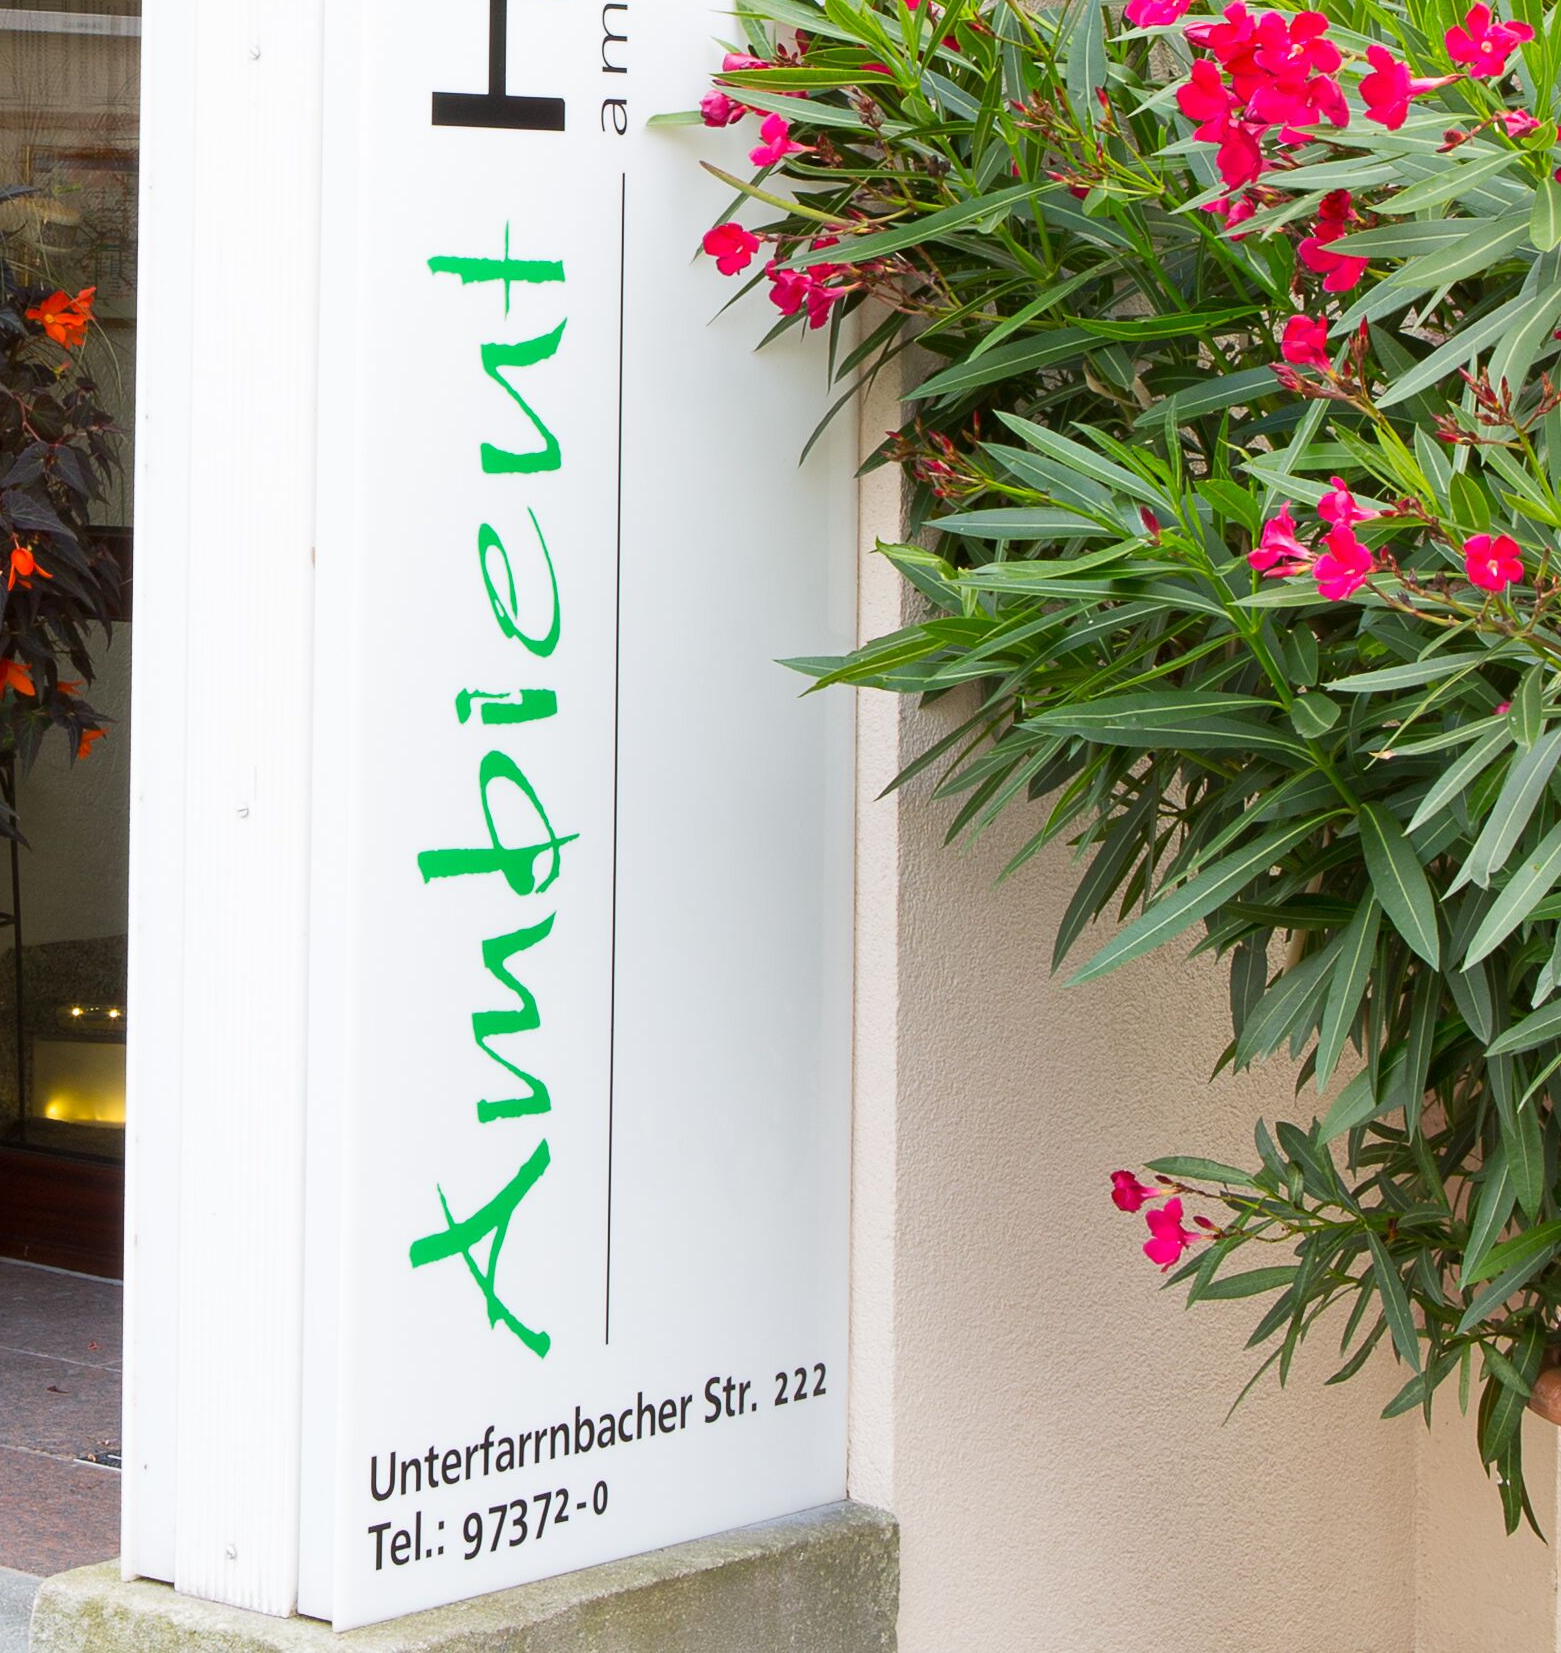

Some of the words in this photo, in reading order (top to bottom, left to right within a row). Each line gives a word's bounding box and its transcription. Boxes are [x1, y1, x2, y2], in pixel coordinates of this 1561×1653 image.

[600, 2, 629, 136] am
[409, 222, 581, 1359] Ambient
[370, 1391, 693, 1502] Unterfarrnbacher
[704, 1375, 758, 1424] Str.
[774, 1362, 827, 1407] 222
[367, 1510, 445, 1571] Tel.:
[462, 1480, 609, 1561] 97372-0
